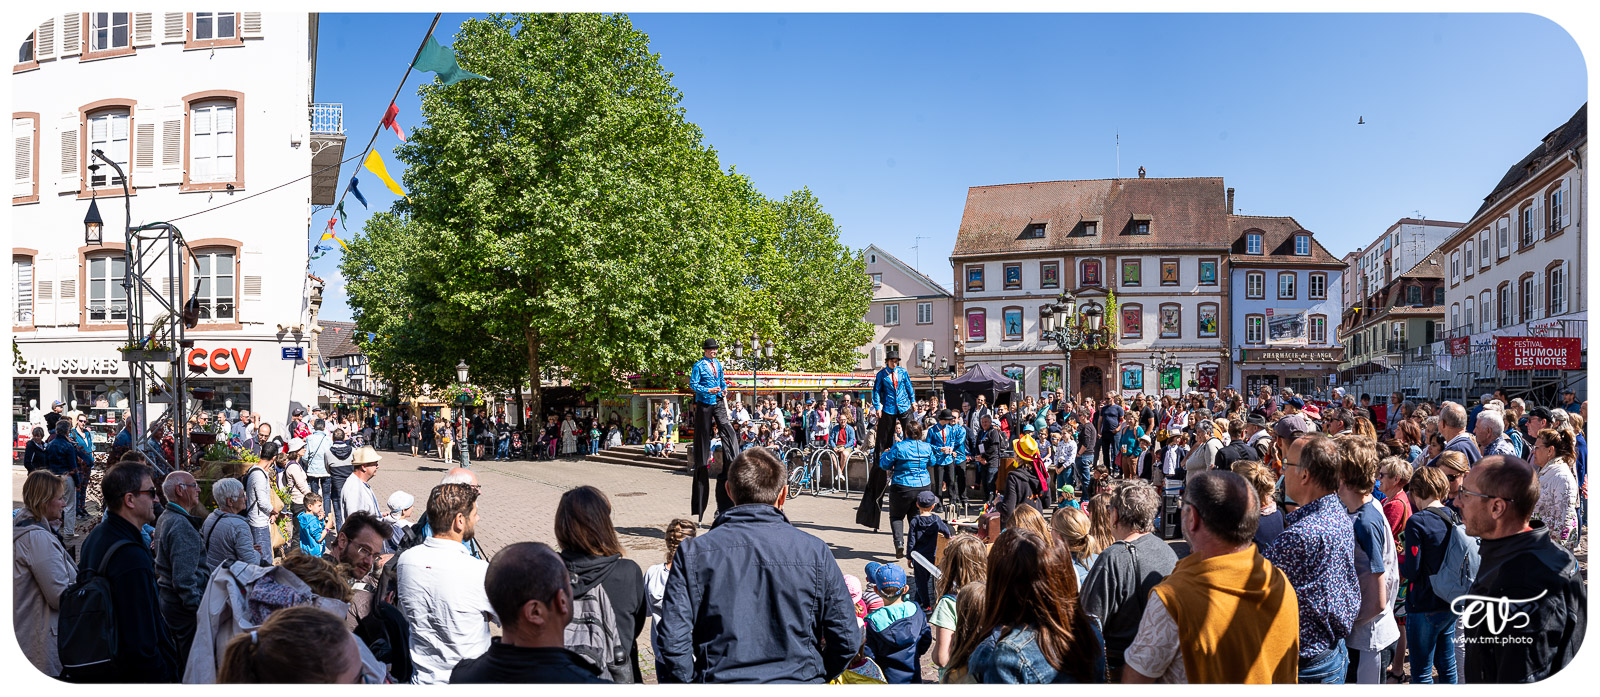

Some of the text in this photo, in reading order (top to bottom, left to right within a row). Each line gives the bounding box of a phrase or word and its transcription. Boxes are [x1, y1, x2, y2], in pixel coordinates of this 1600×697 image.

[1514, 340, 1544, 348] FESTIVAL
[1514, 348, 1567, 357] L'HUMOUR
[15, 357, 119, 374] CHAUSSURES
[187, 347, 252, 375] CCV
[1514, 357, 1567, 366] DES NOTES
